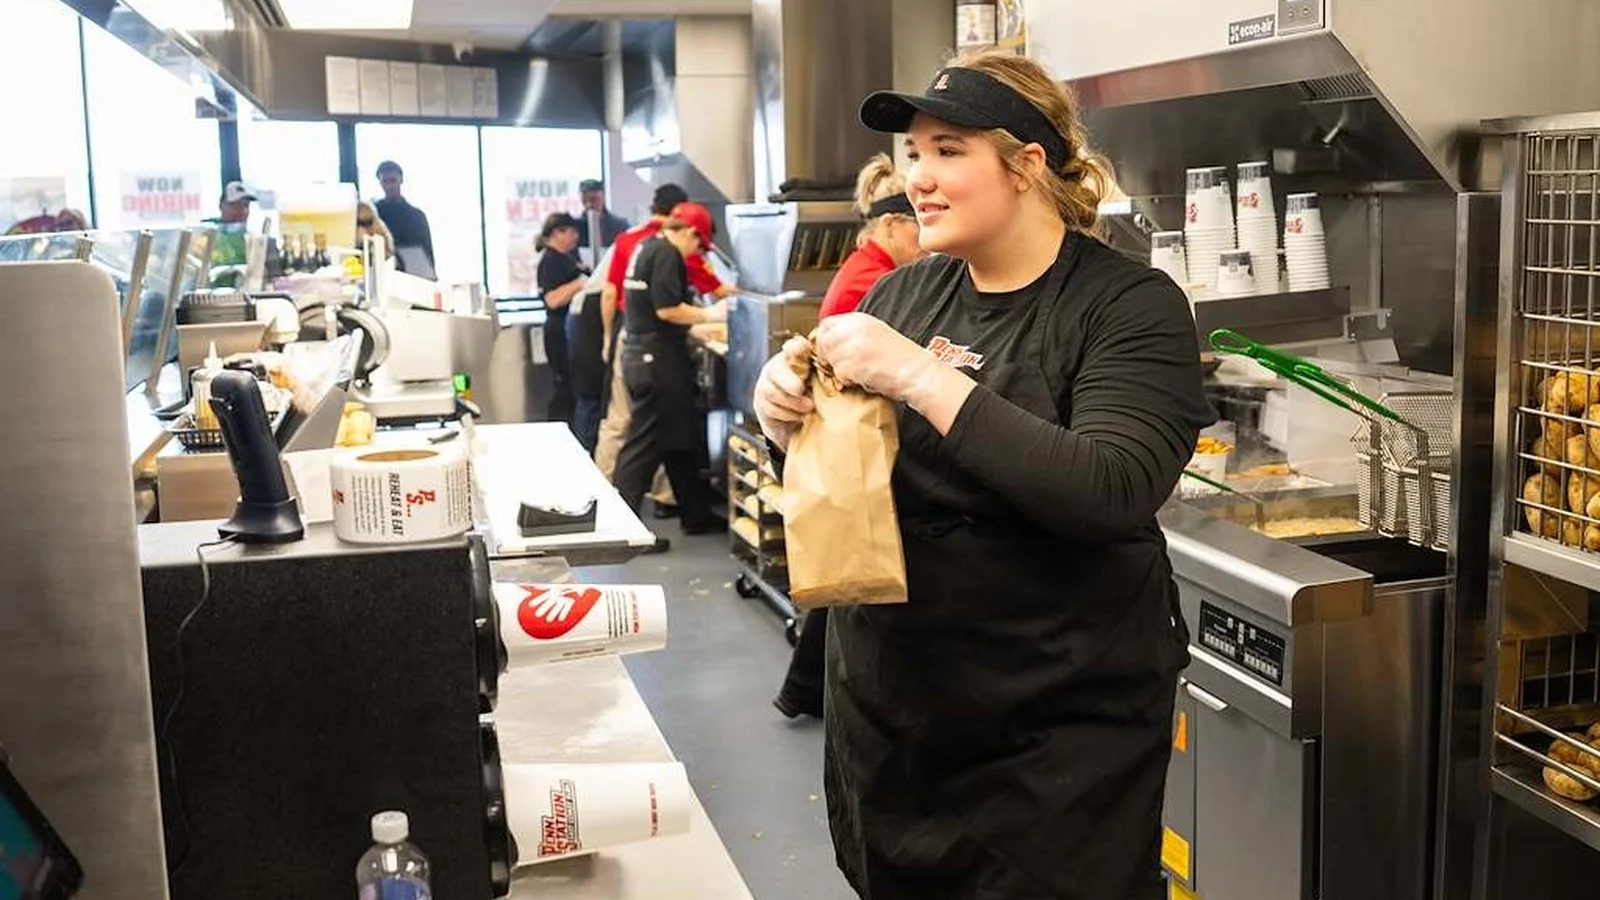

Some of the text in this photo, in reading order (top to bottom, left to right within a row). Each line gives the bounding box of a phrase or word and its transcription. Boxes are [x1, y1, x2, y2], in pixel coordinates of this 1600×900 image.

[389, 472, 402, 508] REHEAT
[392, 519, 404, 536] EAT
[542, 819, 562, 856] PENN
[554, 794, 577, 853] STATION
